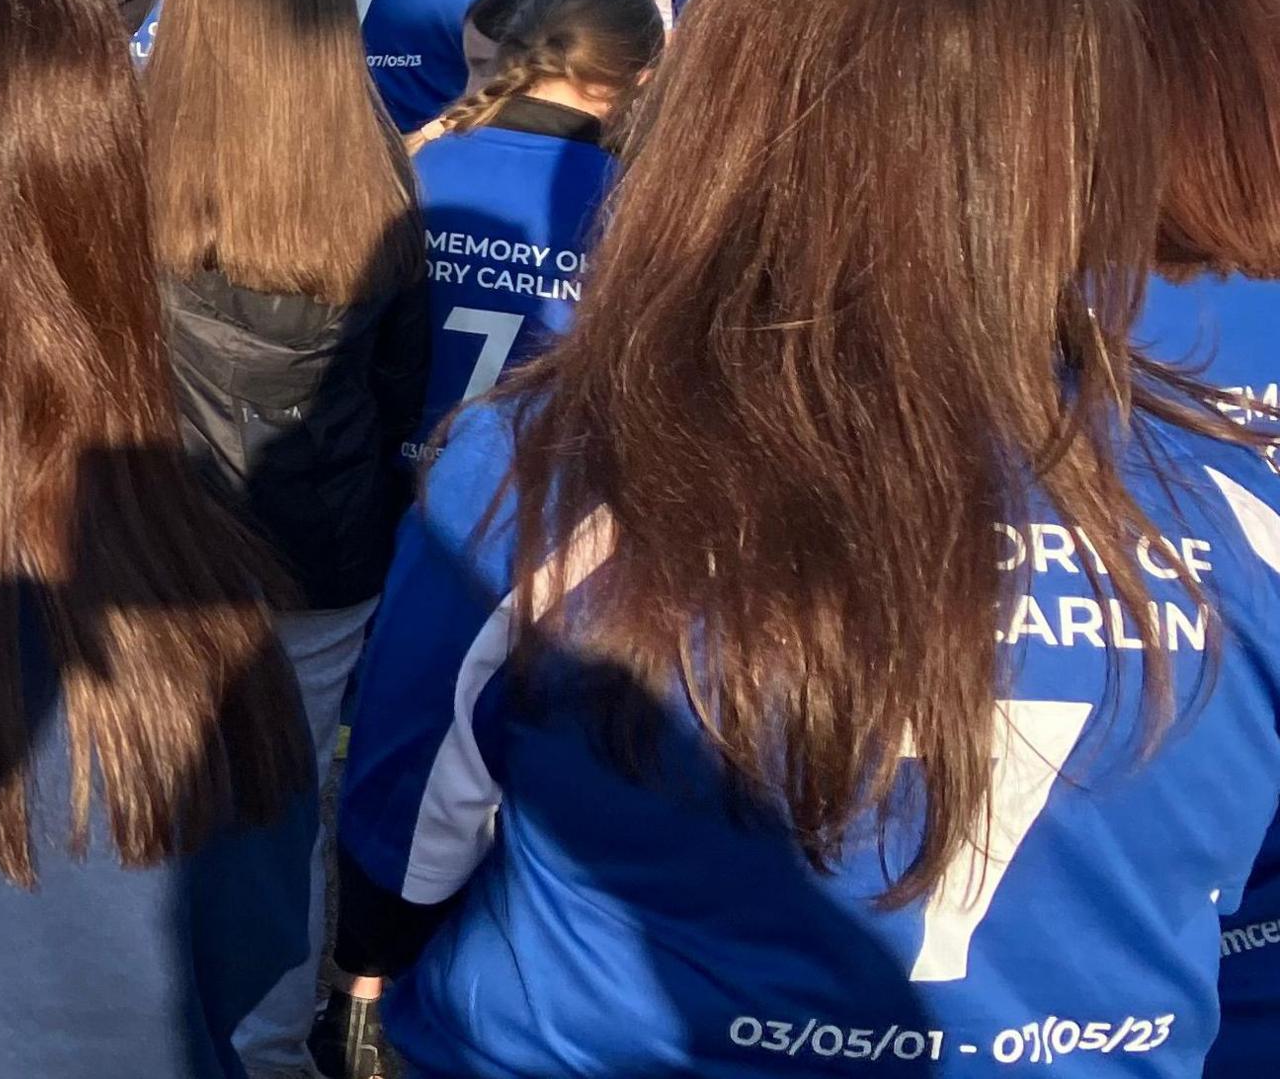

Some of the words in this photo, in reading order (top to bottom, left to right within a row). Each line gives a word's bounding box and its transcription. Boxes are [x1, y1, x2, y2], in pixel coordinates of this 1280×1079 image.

[425, 229, 551, 267] MEMORY
[477, 267, 582, 302] CARLIN
[442, 306, 526, 402] 7
[898, 700, 1093, 982] 7
[729, 1017, 943, 1061] 03/05/01
